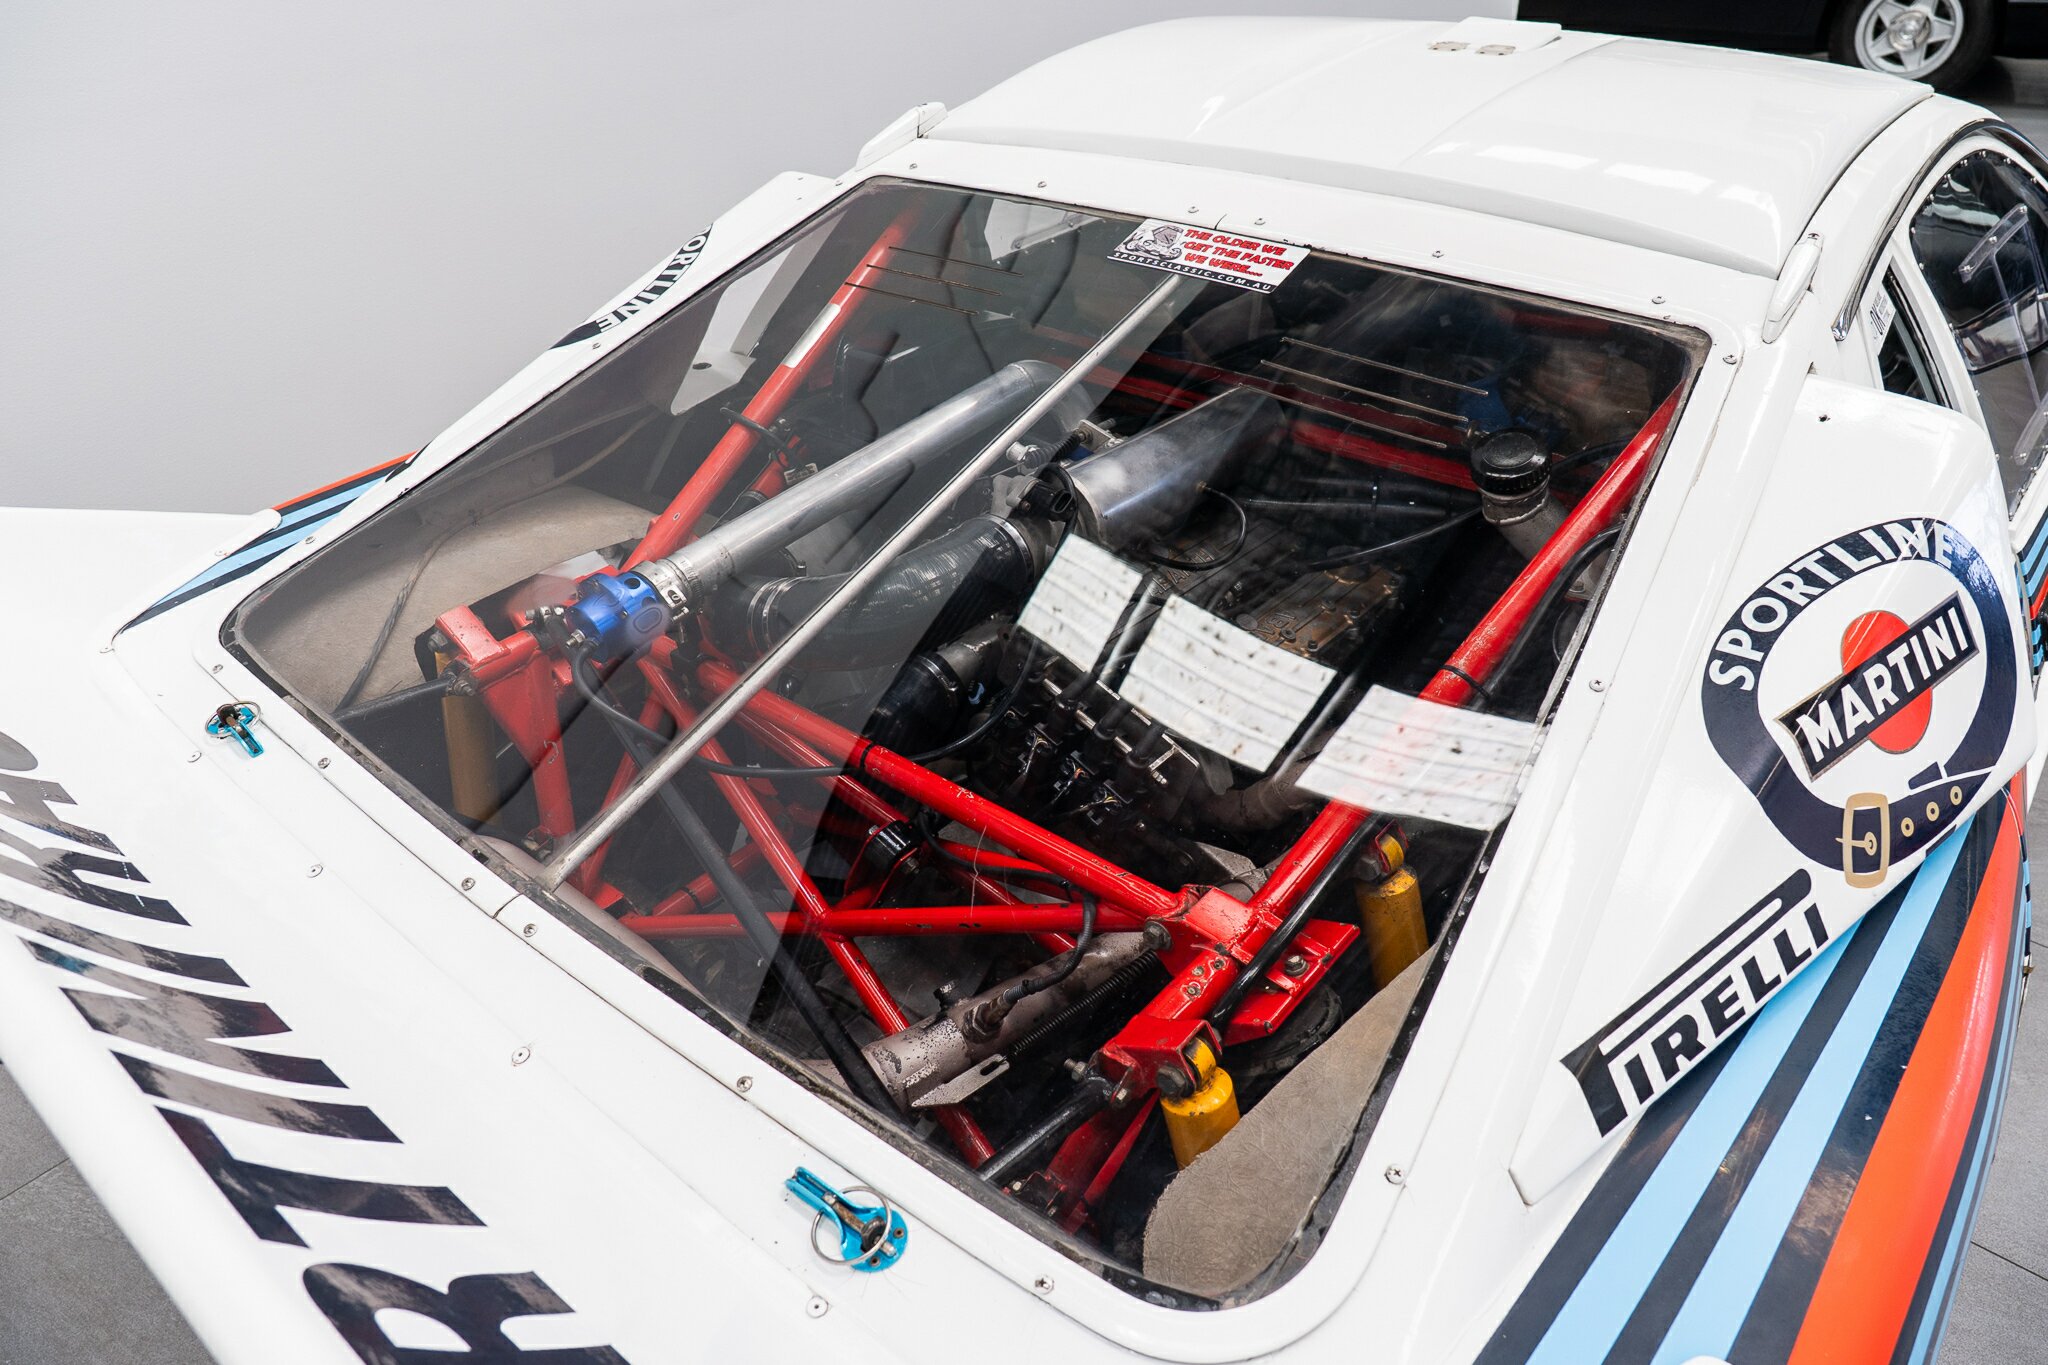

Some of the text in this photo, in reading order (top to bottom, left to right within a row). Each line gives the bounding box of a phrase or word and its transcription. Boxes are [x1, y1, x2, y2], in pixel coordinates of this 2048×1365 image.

[1184, 229, 1287, 256] THE OLDER WE
[1184, 241, 1294, 270] GET THE FASTER
[1184, 252, 1208, 264] WE
[1113, 251, 1271, 291] SPORTSCLASSIC.COM.AU
[1708, 519, 1955, 692] SPORTLINE
[1795, 607, 1969, 764] MARTINI
[1559, 868, 1829, 1138] PIRELLI
